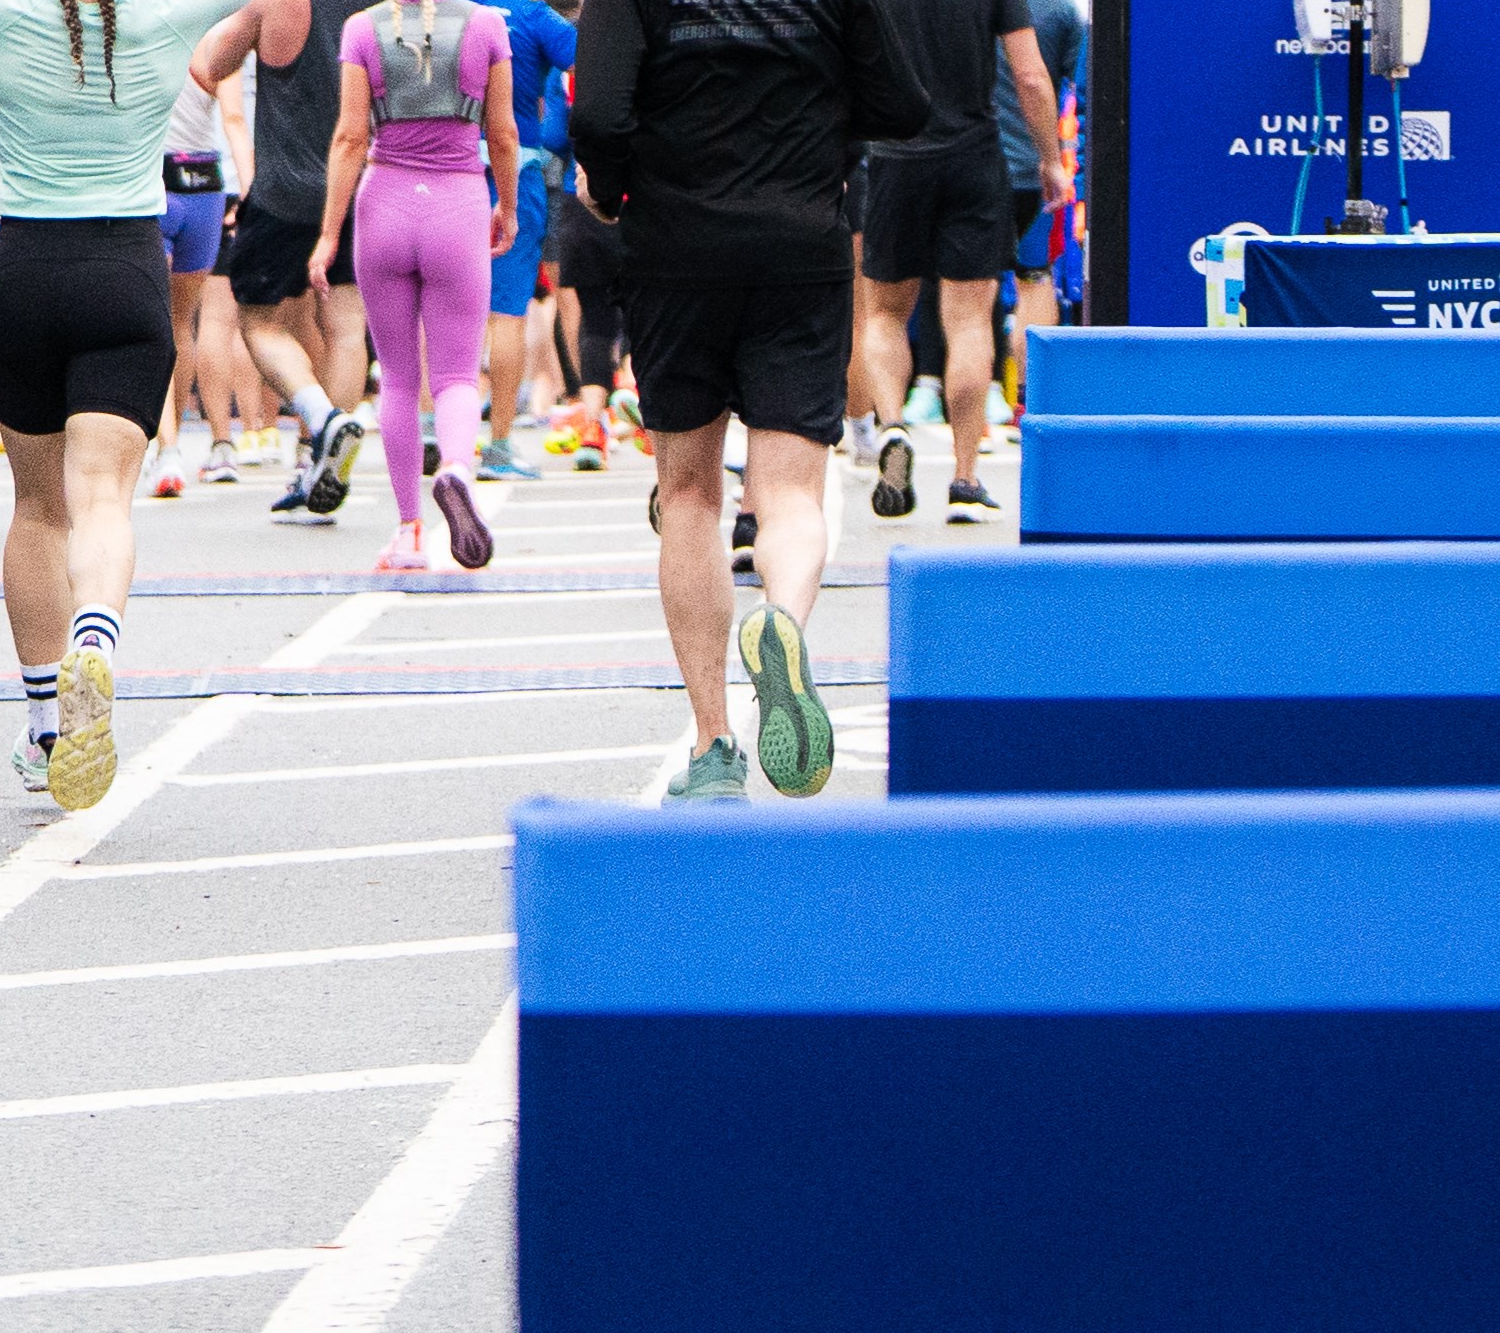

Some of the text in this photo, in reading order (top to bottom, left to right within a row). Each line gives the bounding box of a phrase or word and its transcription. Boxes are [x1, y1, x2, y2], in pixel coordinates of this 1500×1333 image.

[1262, 115, 1389, 133] UNITD
[1428, 279, 1496, 291] UNITED
[1428, 300, 1500, 328] NYC
